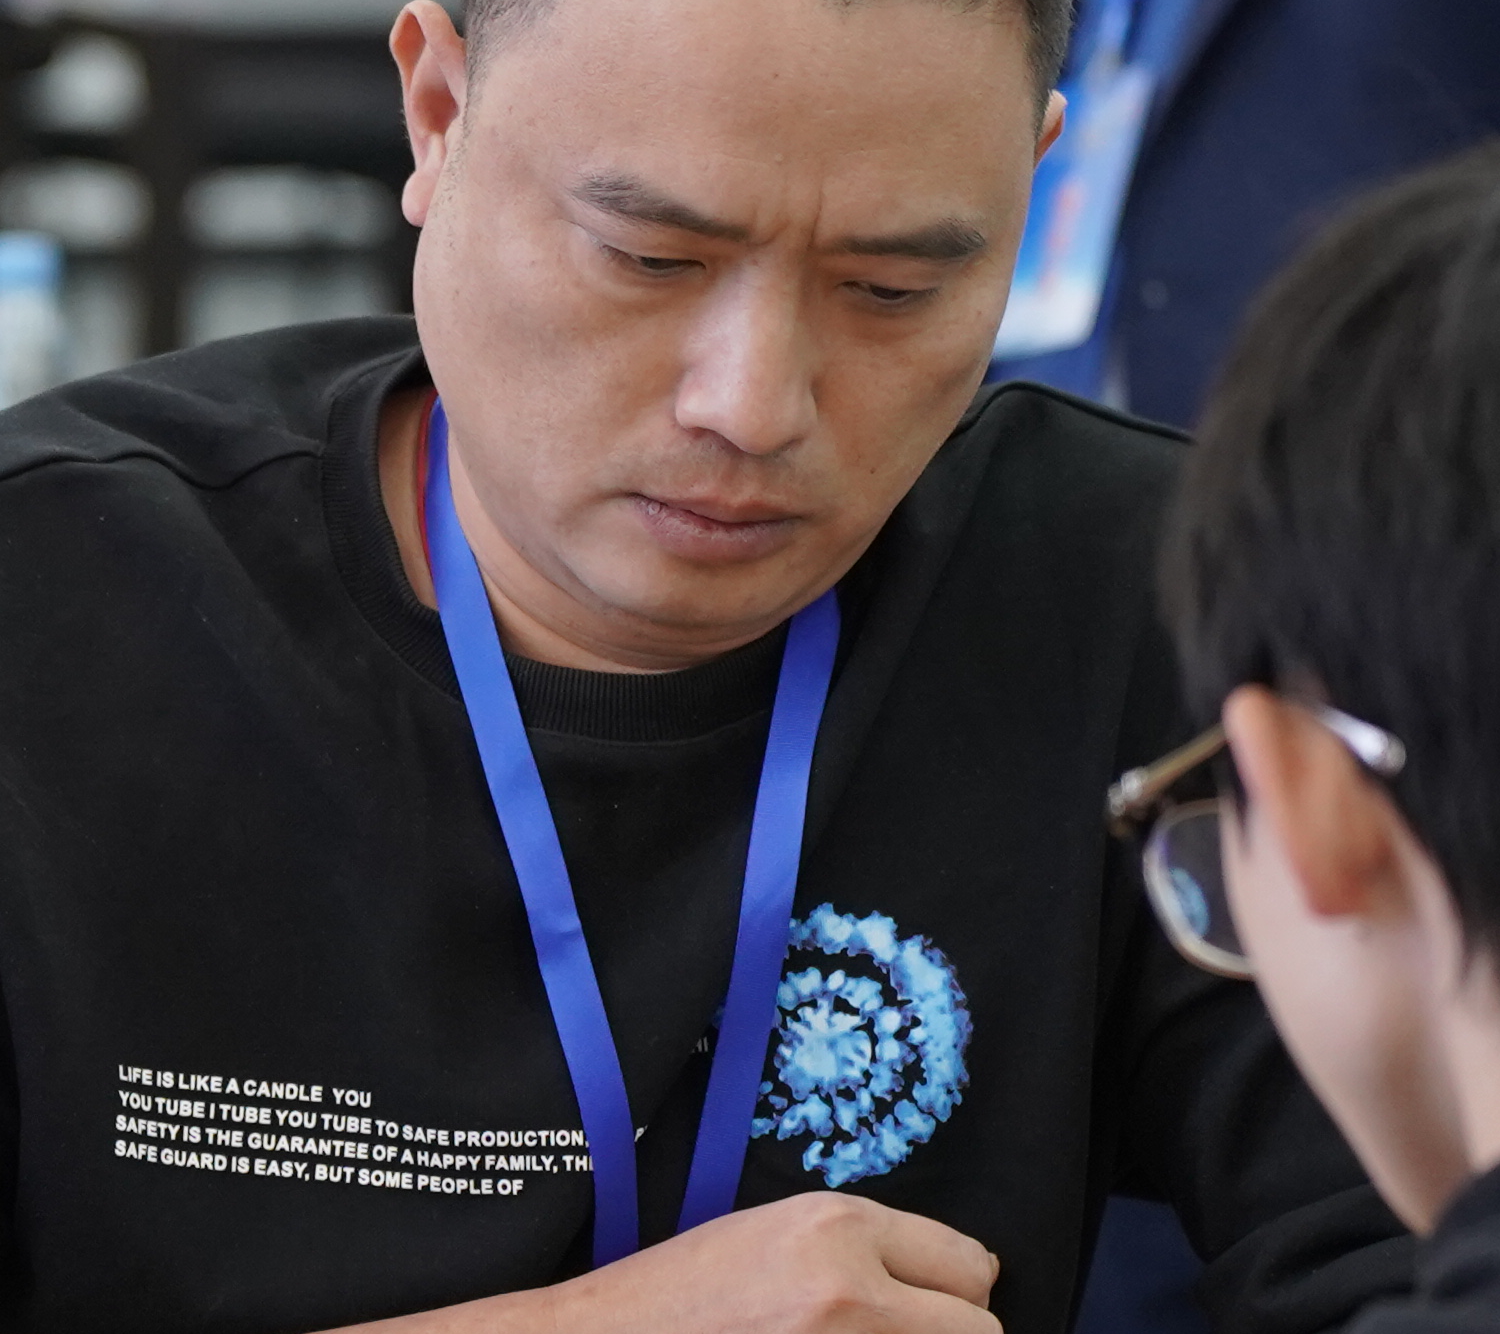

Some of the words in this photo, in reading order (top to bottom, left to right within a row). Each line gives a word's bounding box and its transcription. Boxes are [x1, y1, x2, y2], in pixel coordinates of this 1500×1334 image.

[118, 1064, 153, 1086] LIFE
[156, 1070, 175, 1089] IS
[178, 1072, 224, 1094] LIKE
[225, 1077, 241, 1095] A
[242, 1079, 324, 1103] CANDLE
[332, 1087, 372, 1109] YOU
[115, 1114, 181, 1141] SAFETY
[182, 1125, 202, 1144] IS
[204, 1127, 244, 1148] THE
[247, 1131, 370, 1160] GUARANTEE
[372, 1144, 399, 1163] OF
[400, 1148, 415, 1165] A
[416, 1150, 482, 1171] HAPPY
[484, 1154, 559, 1174] FAMILY,
[118, 1089, 153, 1112] YOU
[154, 1096, 206, 1119] TUBE
[218, 1103, 272, 1125] TUBE
[275, 1109, 317, 1129] YOU
[320, 1113, 373, 1135] TUBE
[374, 1119, 400, 1139] TO
[402, 1124, 450, 1147] SAFE
[114, 1139, 158, 1163] SAFE
[160, 1147, 228, 1172] GUARD
[231, 1155, 250, 1174] IS
[253, 1157, 310, 1182] EASY,
[314, 1163, 356, 1184] BUT
[357, 1167, 414, 1190] SOME
[417, 1173, 494, 1195] PEOPLE
[496, 1178, 524, 1196] OF
